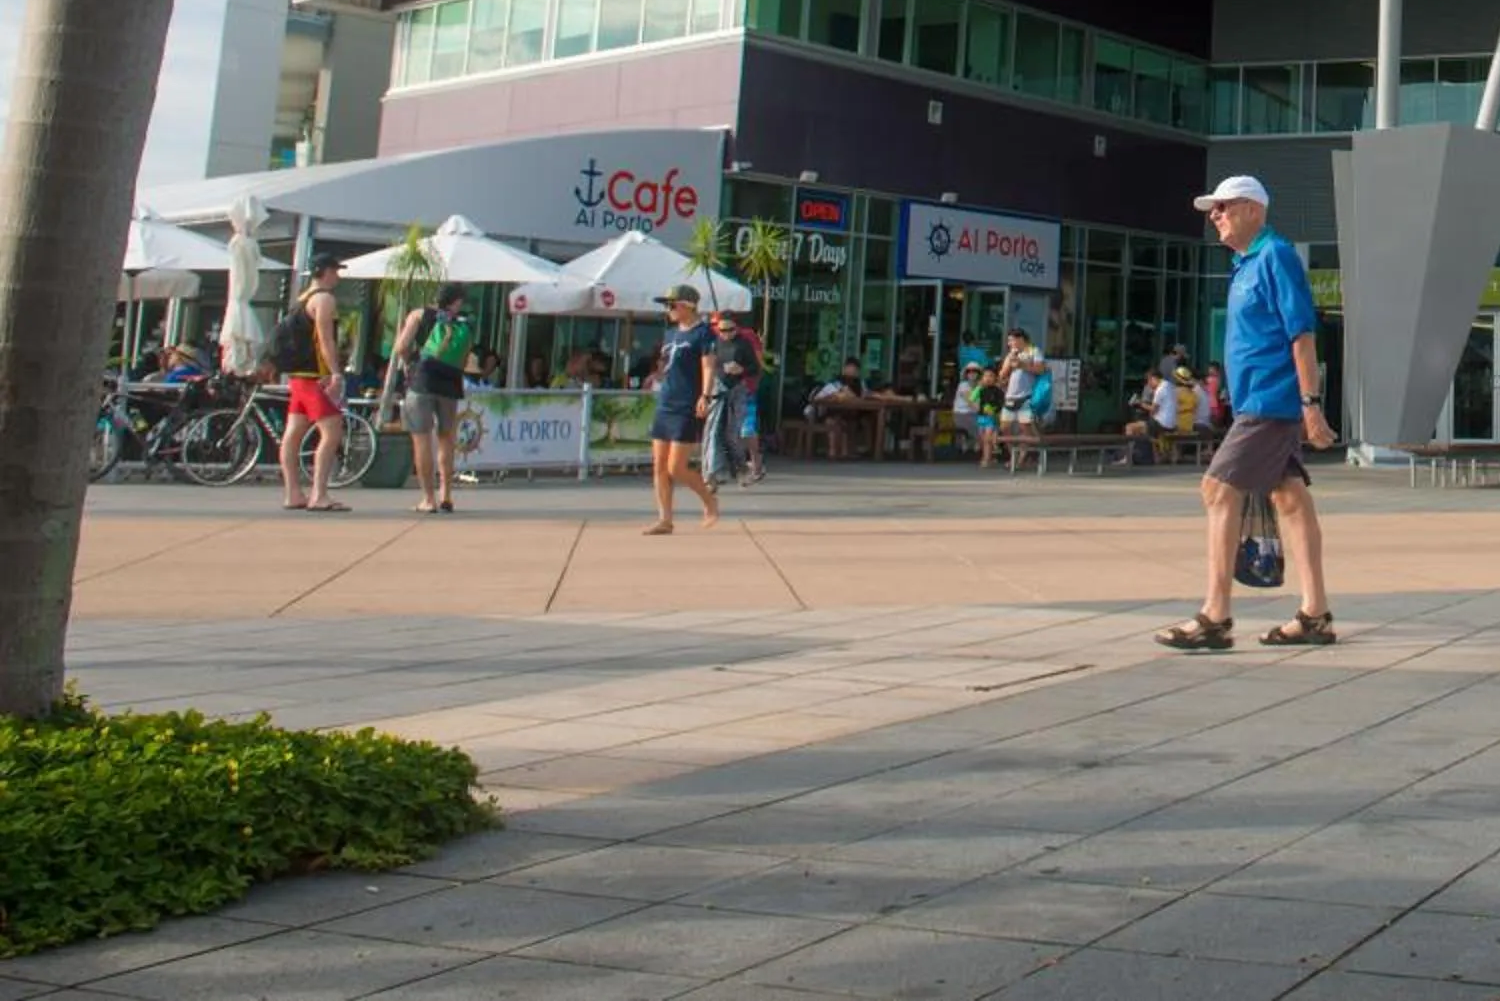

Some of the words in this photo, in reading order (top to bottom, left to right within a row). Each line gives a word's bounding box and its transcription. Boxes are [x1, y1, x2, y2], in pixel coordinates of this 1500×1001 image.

[608, 168, 698, 227] Cafe
[575, 208, 596, 228] Al
[800, 200, 840, 223] OPEN
[808, 233, 847, 272] Days
[958, 229, 979, 253] Al
[987, 229, 1039, 259] Porto
[1020, 259, 1045, 276] Cafe
[804, 283, 841, 303] Lunch
[496, 420, 515, 441] AL
[519, 420, 572, 441] PORTO
